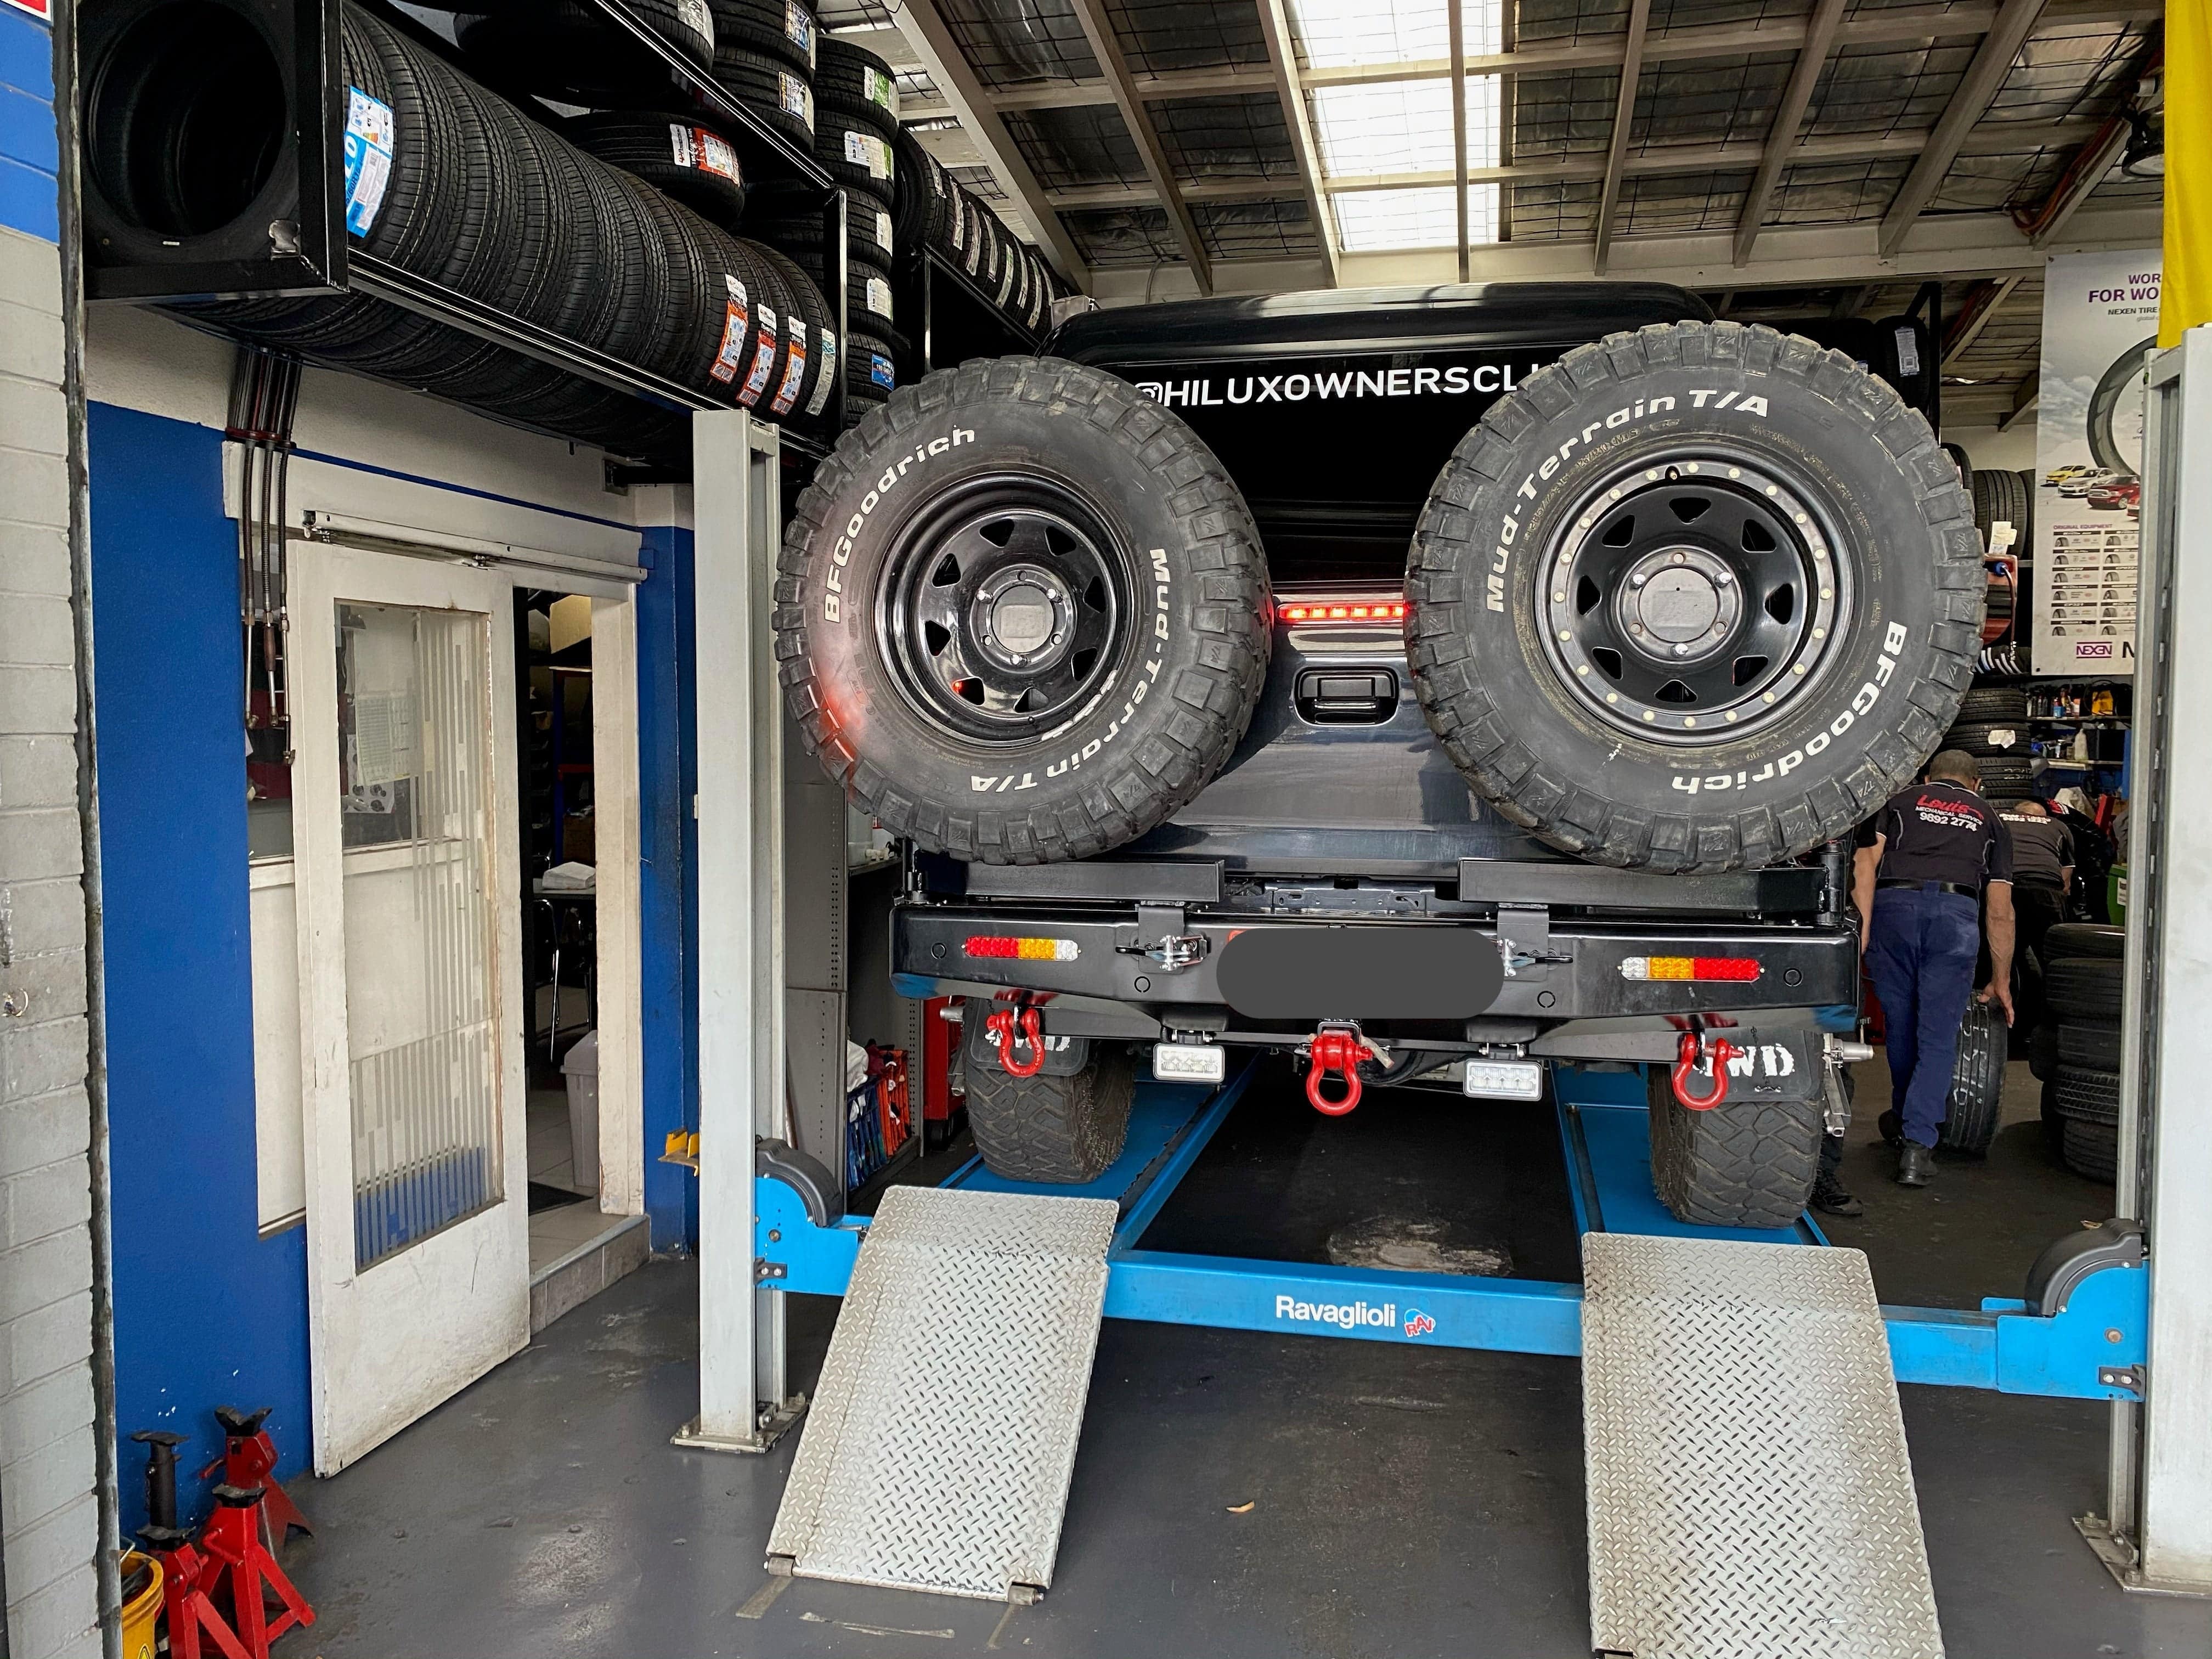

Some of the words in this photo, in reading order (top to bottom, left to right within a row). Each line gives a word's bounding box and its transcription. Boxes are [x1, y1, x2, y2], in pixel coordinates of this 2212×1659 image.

[2129, 273, 2162, 285] WOR
[2089, 289, 2125, 302] FOR
[2131, 286, 2159, 301] WO
[1164, 362, 1557, 408] HILUXOWNERSCL
[1486, 396, 1674, 613] Mud-Terrain
[1689, 389, 1769, 417] T/A
[823, 424, 975, 624] BFGoodrich
[2076, 645, 2112, 656] NEXEN
[1046, 548, 1170, 780] Mud-Terrain
[1672, 621, 1909, 794] BFGoodrich
[971, 774, 1038, 793] T/A
[1916, 794, 1971, 814] Louis
[1915, 806, 1956, 817] MECHANICAL
[1958, 813, 1984, 826] SERVICE
[1919, 812, 1949, 825] 9892
[1950, 816, 1977, 832] 2774
[1276, 1295, 1396, 1330] Ravaglioli
[1403, 1315, 1435, 1338] RAV
